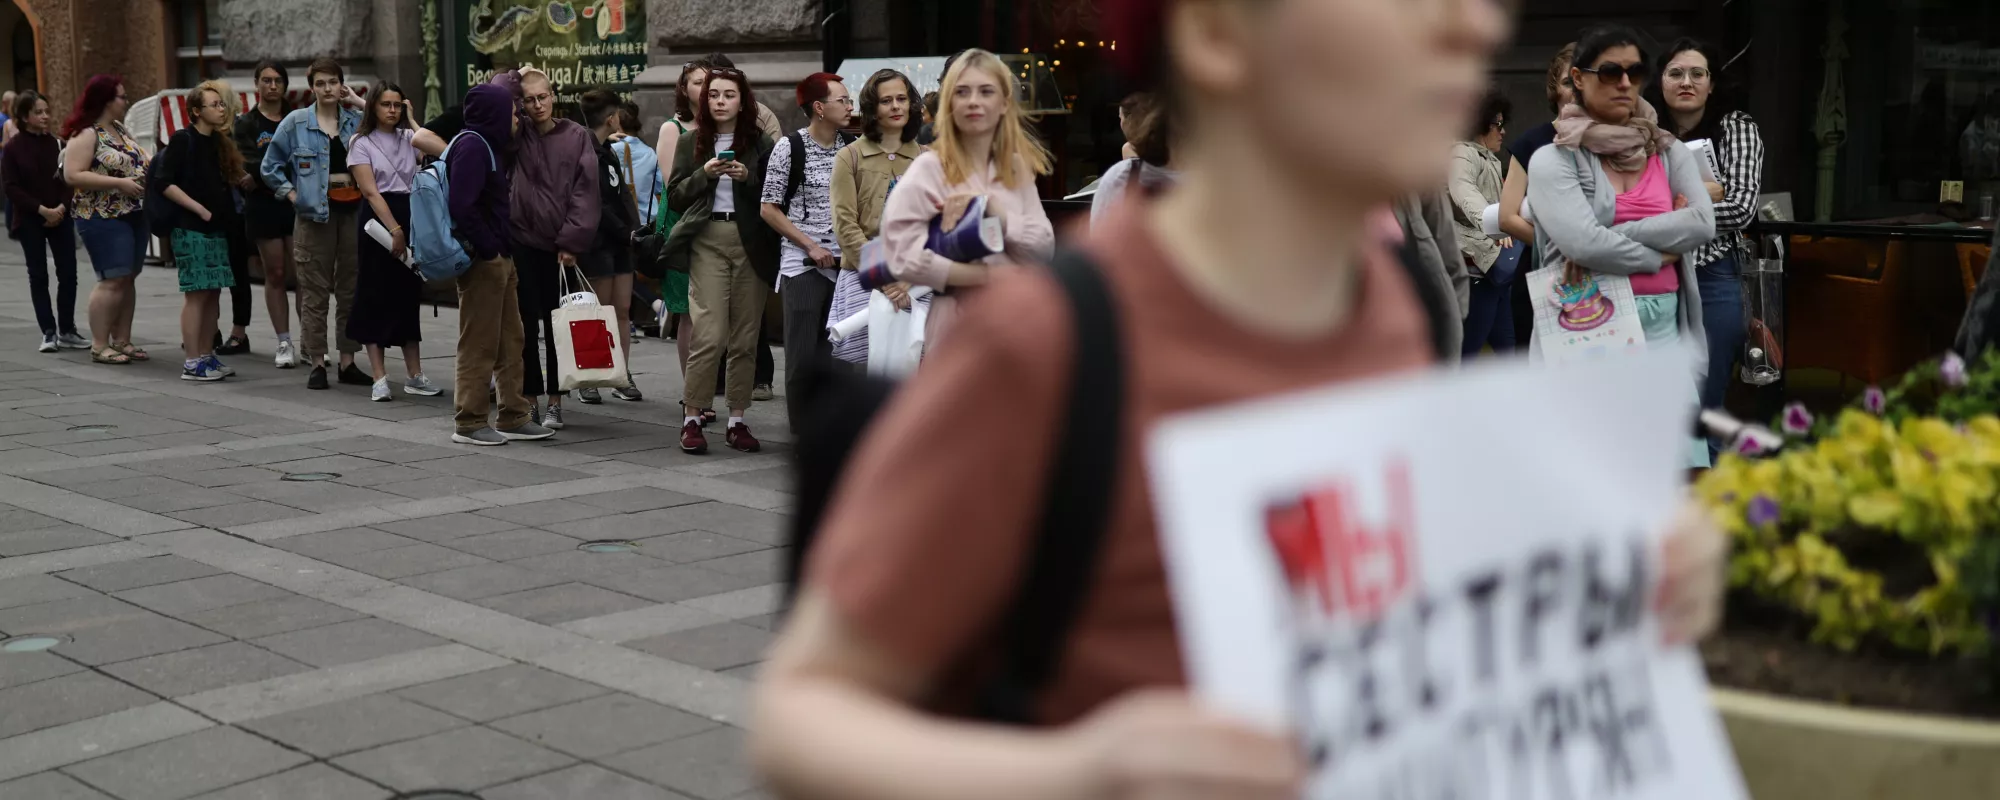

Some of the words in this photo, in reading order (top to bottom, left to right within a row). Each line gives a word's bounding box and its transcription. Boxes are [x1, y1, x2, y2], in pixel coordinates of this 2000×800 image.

[574, 42, 601, 57] Sterlet
[582, 63, 646, 86] 欧洲鳇鱼子
